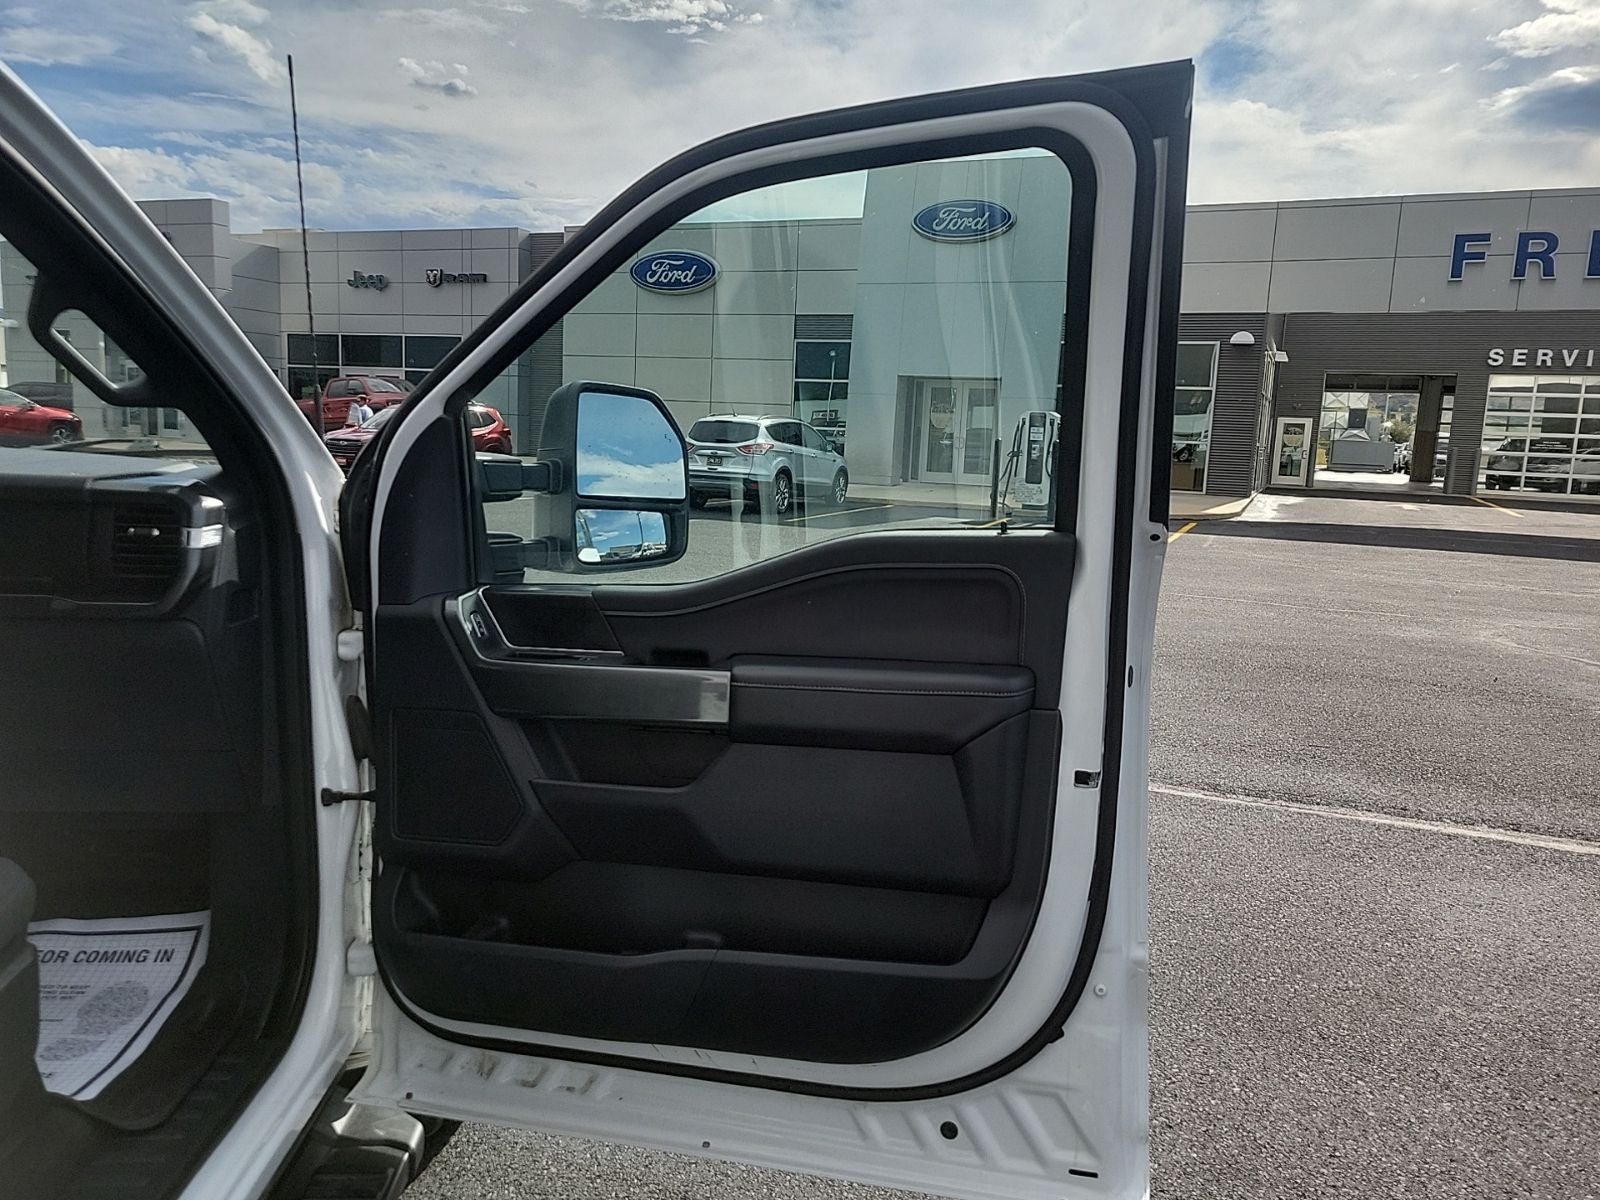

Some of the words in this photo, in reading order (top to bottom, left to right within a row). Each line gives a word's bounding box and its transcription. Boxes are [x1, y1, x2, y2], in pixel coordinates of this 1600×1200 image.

[932, 207, 989, 232] Ford
[347, 270, 387, 291] Jeep
[646, 259, 696, 283] Ford
[1487, 348, 1594, 367] SERVI
[73, 949, 149, 963] COMING
[153, 948, 175, 963] IN
